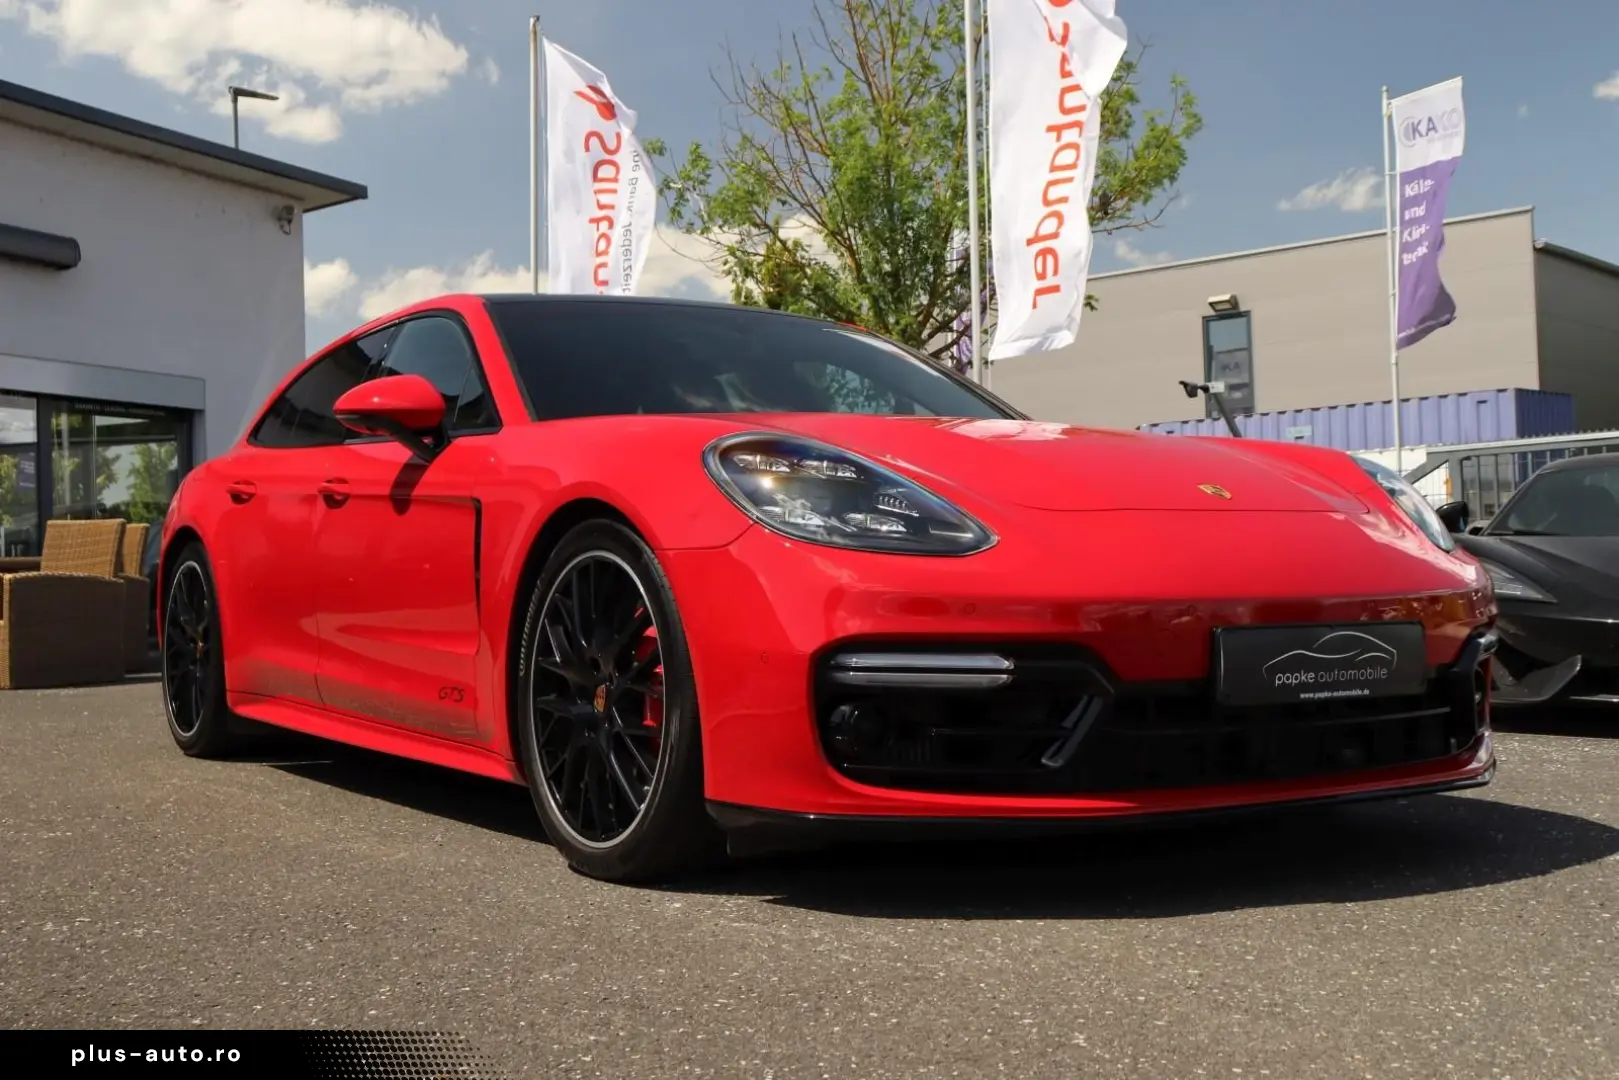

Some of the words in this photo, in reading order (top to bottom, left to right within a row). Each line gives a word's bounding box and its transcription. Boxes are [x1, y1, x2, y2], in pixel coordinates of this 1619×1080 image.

[1275, 671, 1316, 687] papke
[1317, 666, 1388, 683] automobile
[438, 686, 465, 703] GTS
[1299, 688, 1370, 699] www.papke-automobile.de
